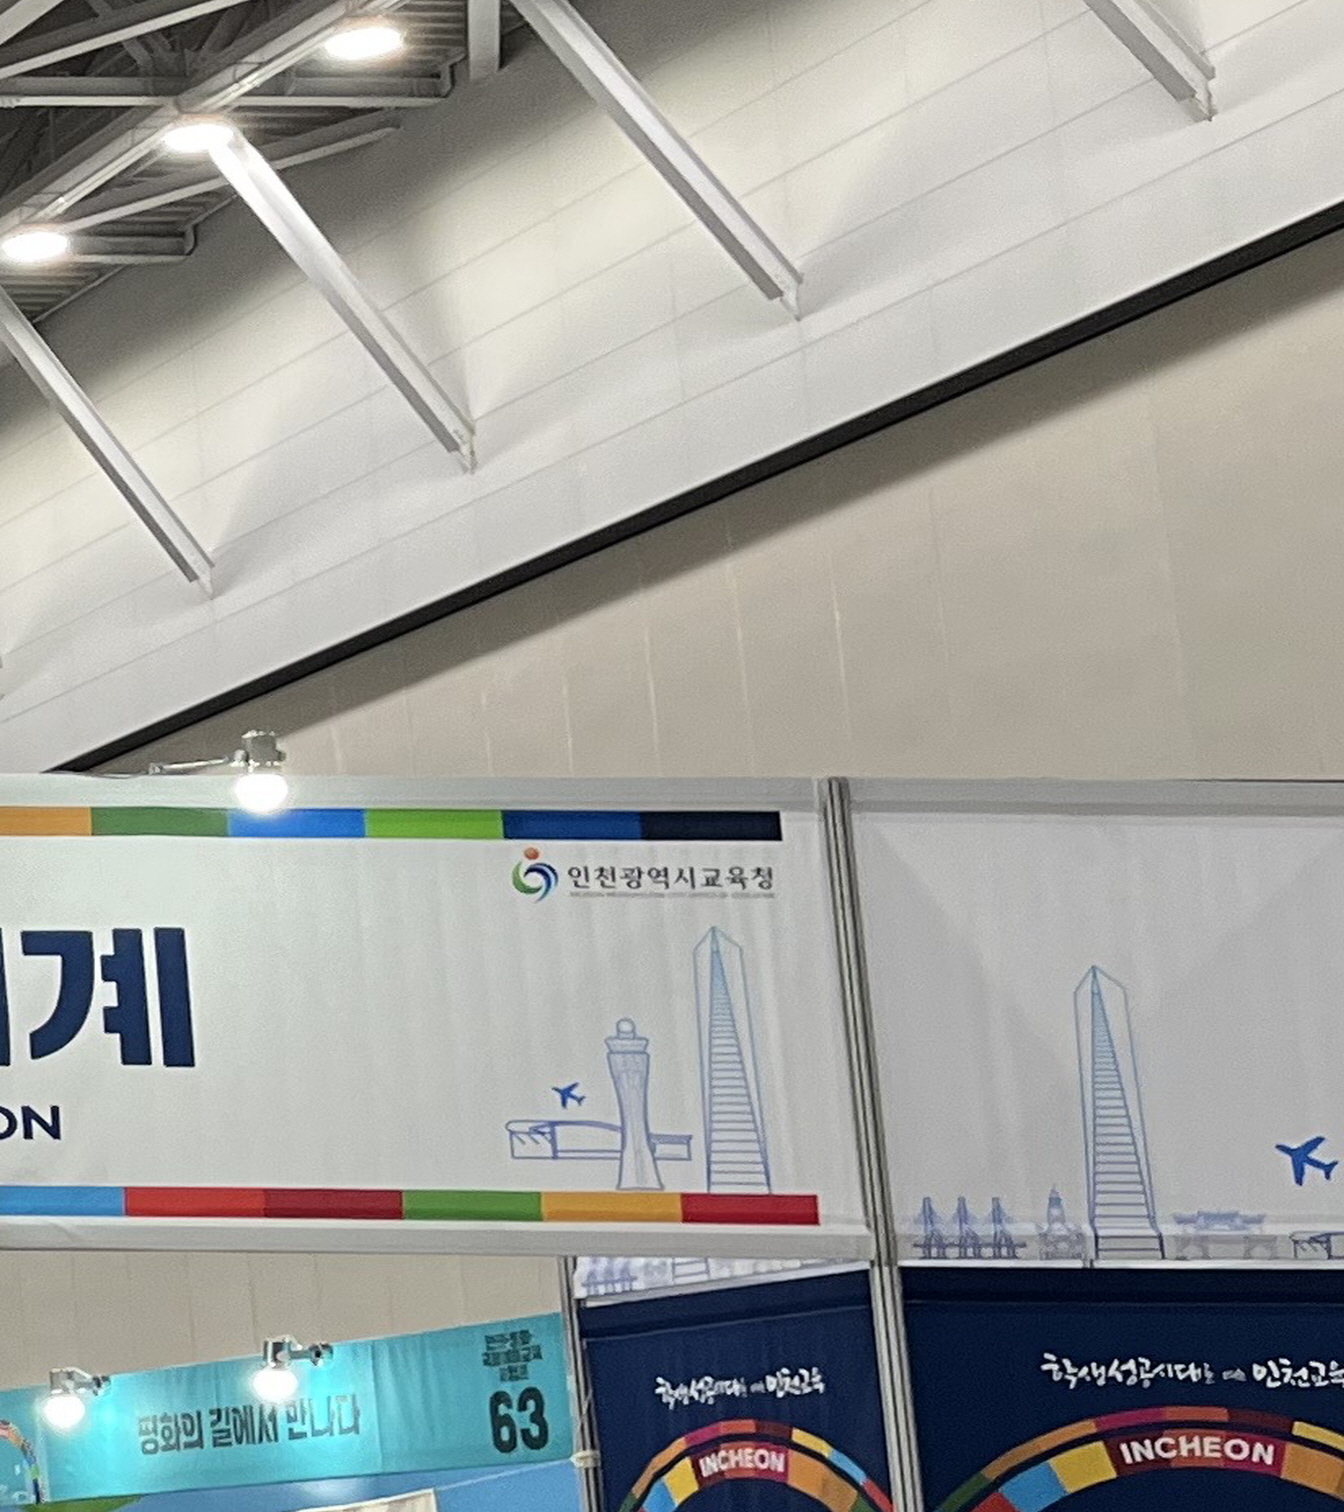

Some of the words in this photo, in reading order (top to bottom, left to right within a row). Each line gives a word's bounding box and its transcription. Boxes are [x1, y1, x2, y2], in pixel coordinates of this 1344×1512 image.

[566, 864, 773, 891] 인천광역시교육청
[138, 1409, 203, 1456] 평화의
[212, 1403, 279, 1448] 길에서
[285, 1392, 361, 1438] 만나다
[489, 1386, 550, 1454] 63
[698, 1448, 786, 1478] INCHEON
[1119, 1436, 1274, 1466] INCHEON
